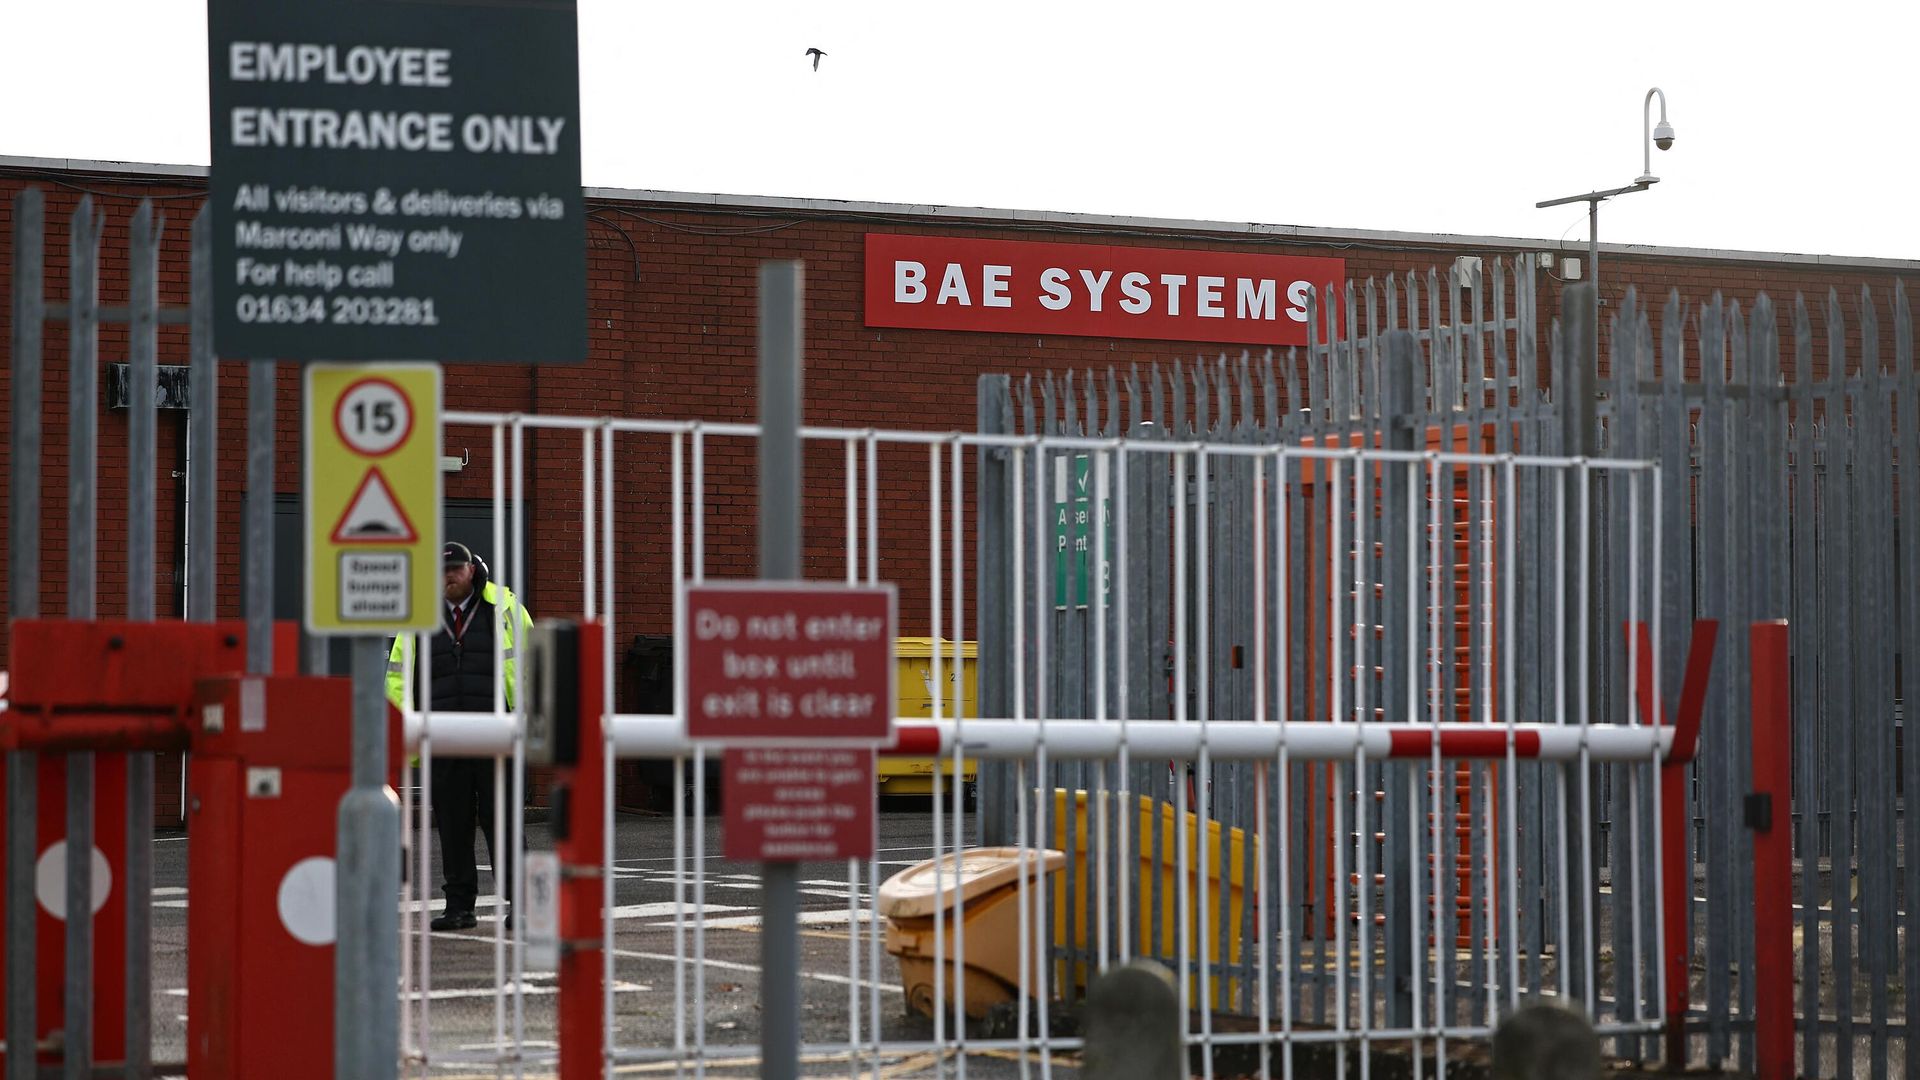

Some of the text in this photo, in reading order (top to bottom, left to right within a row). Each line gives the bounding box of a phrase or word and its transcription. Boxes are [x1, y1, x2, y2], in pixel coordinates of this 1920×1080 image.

[229, 43, 451, 87] EMPLOYEE
[231, 107, 565, 154] ENTRANCE ONLY
[234, 185, 564, 219] All visitors & deliveries via
[235, 222, 463, 258] Marconi Way only
[236, 259, 393, 291] For help call
[894, 260, 1315, 323] BAE SYSTEMS
[236, 295, 438, 325] 01634 203281
[352, 401, 396, 434] 15
[351, 559, 400, 576] Speed
[348, 579, 401, 596] bumps
[351, 598, 400, 613] ahead
[695, 609, 883, 641] Do not enter
[723, 650, 856, 679] box until
[702, 688, 875, 718] exit is clear
